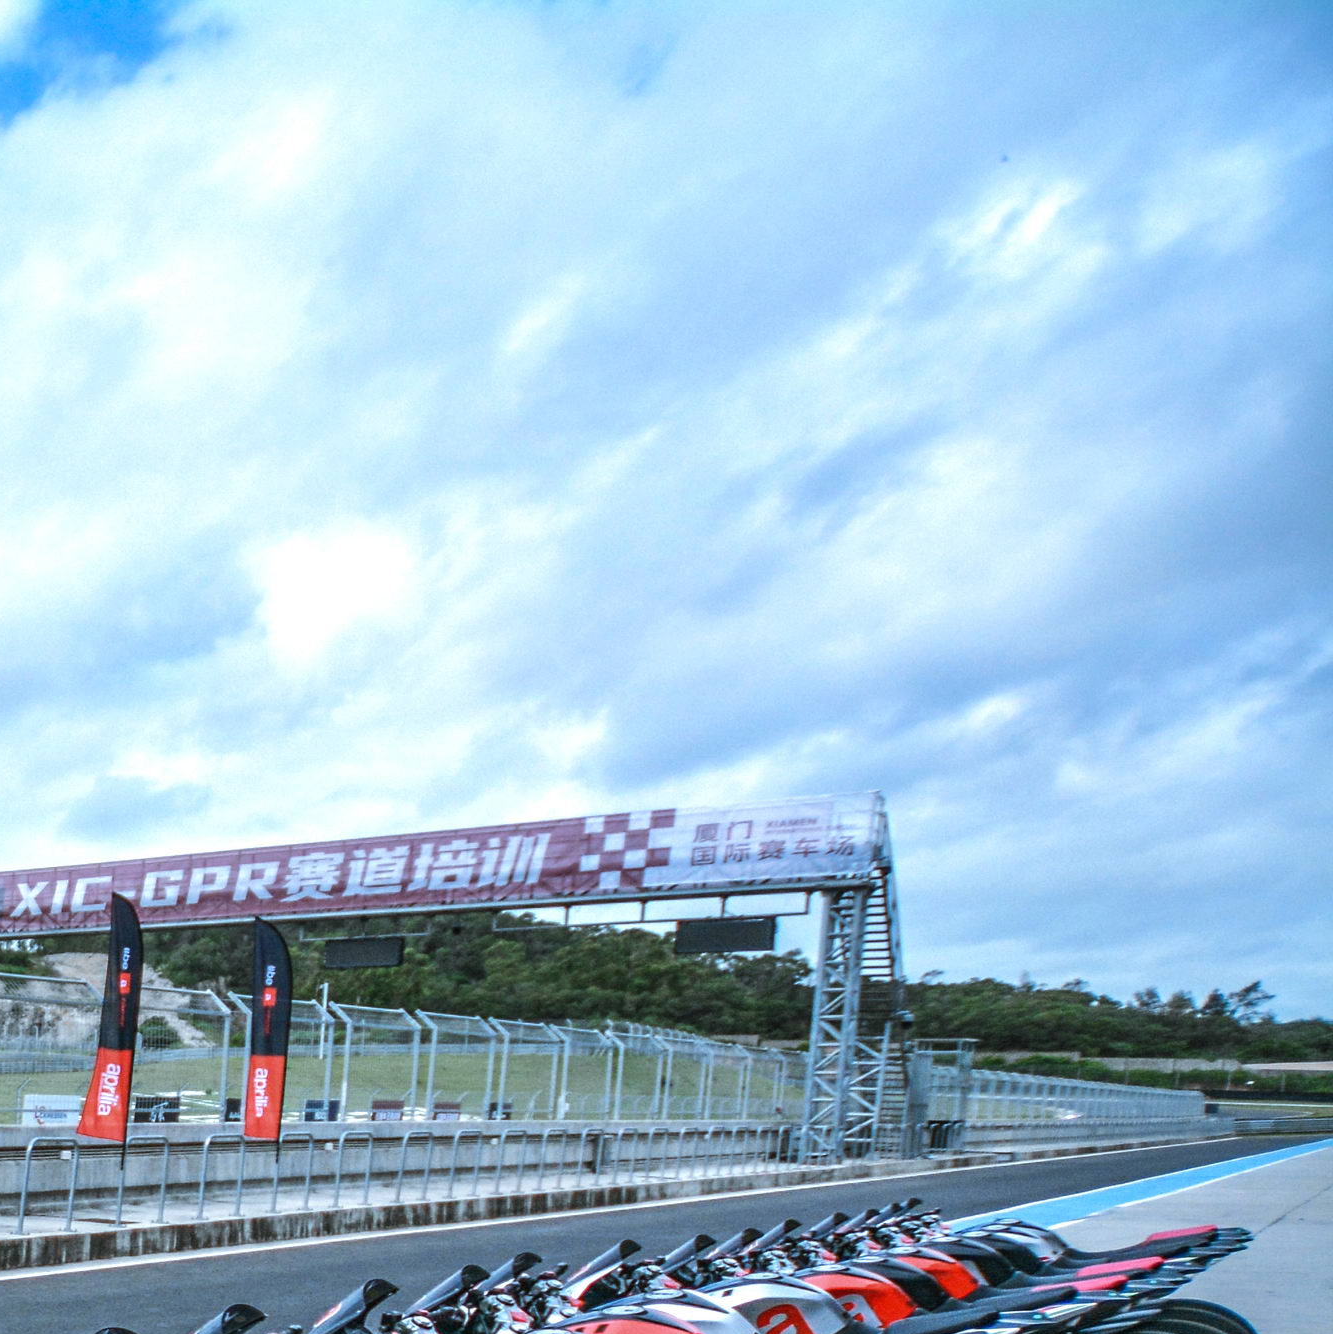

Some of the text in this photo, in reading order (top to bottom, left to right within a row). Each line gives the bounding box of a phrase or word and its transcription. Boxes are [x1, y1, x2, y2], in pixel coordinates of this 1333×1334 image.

[690, 836, 854, 866] 国际赛车场
[694, 820, 753, 843] 厦门
[97, 1063, 121, 1116] aprilia
[253, 1067, 269, 1118] aprilia
